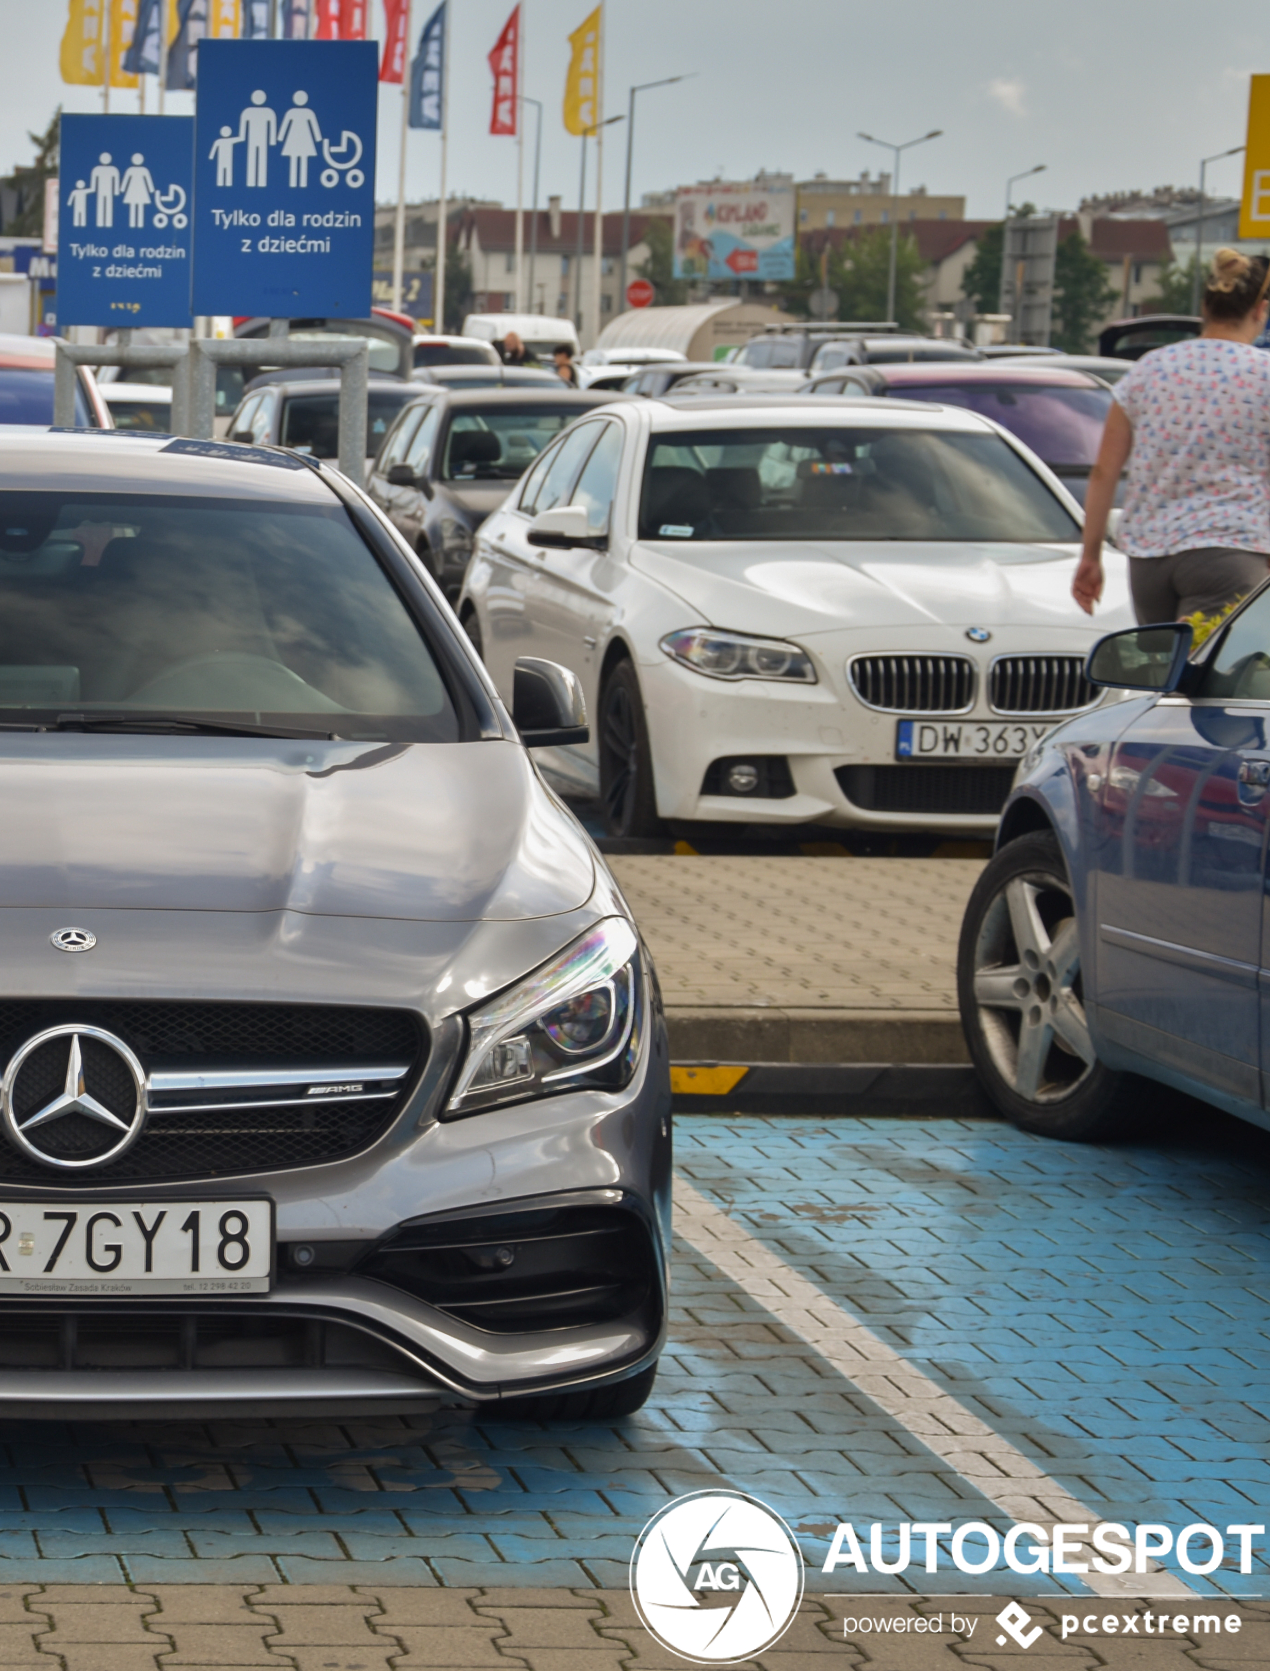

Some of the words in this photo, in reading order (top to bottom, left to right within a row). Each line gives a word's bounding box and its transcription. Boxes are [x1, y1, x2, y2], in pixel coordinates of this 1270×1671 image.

[211, 209, 261, 229] Tylko
[267, 209, 296, 227] dla
[302, 210, 362, 227] rodzin
[70, 243, 108, 260] Tylko
[113, 244, 135, 258] dla
[139, 245, 186, 259] rodzin
[241, 239, 251, 252] z
[257, 234, 331, 253] dziećmi
[92, 266, 101, 278] z
[105, 263, 162, 278] dziećmi
[918, 725, 962, 753] DW
[974, 725, 1047, 754] 363Y
[324, 1084, 363, 1094] AMG
[42, 1208, 251, 1274] 7GY18
